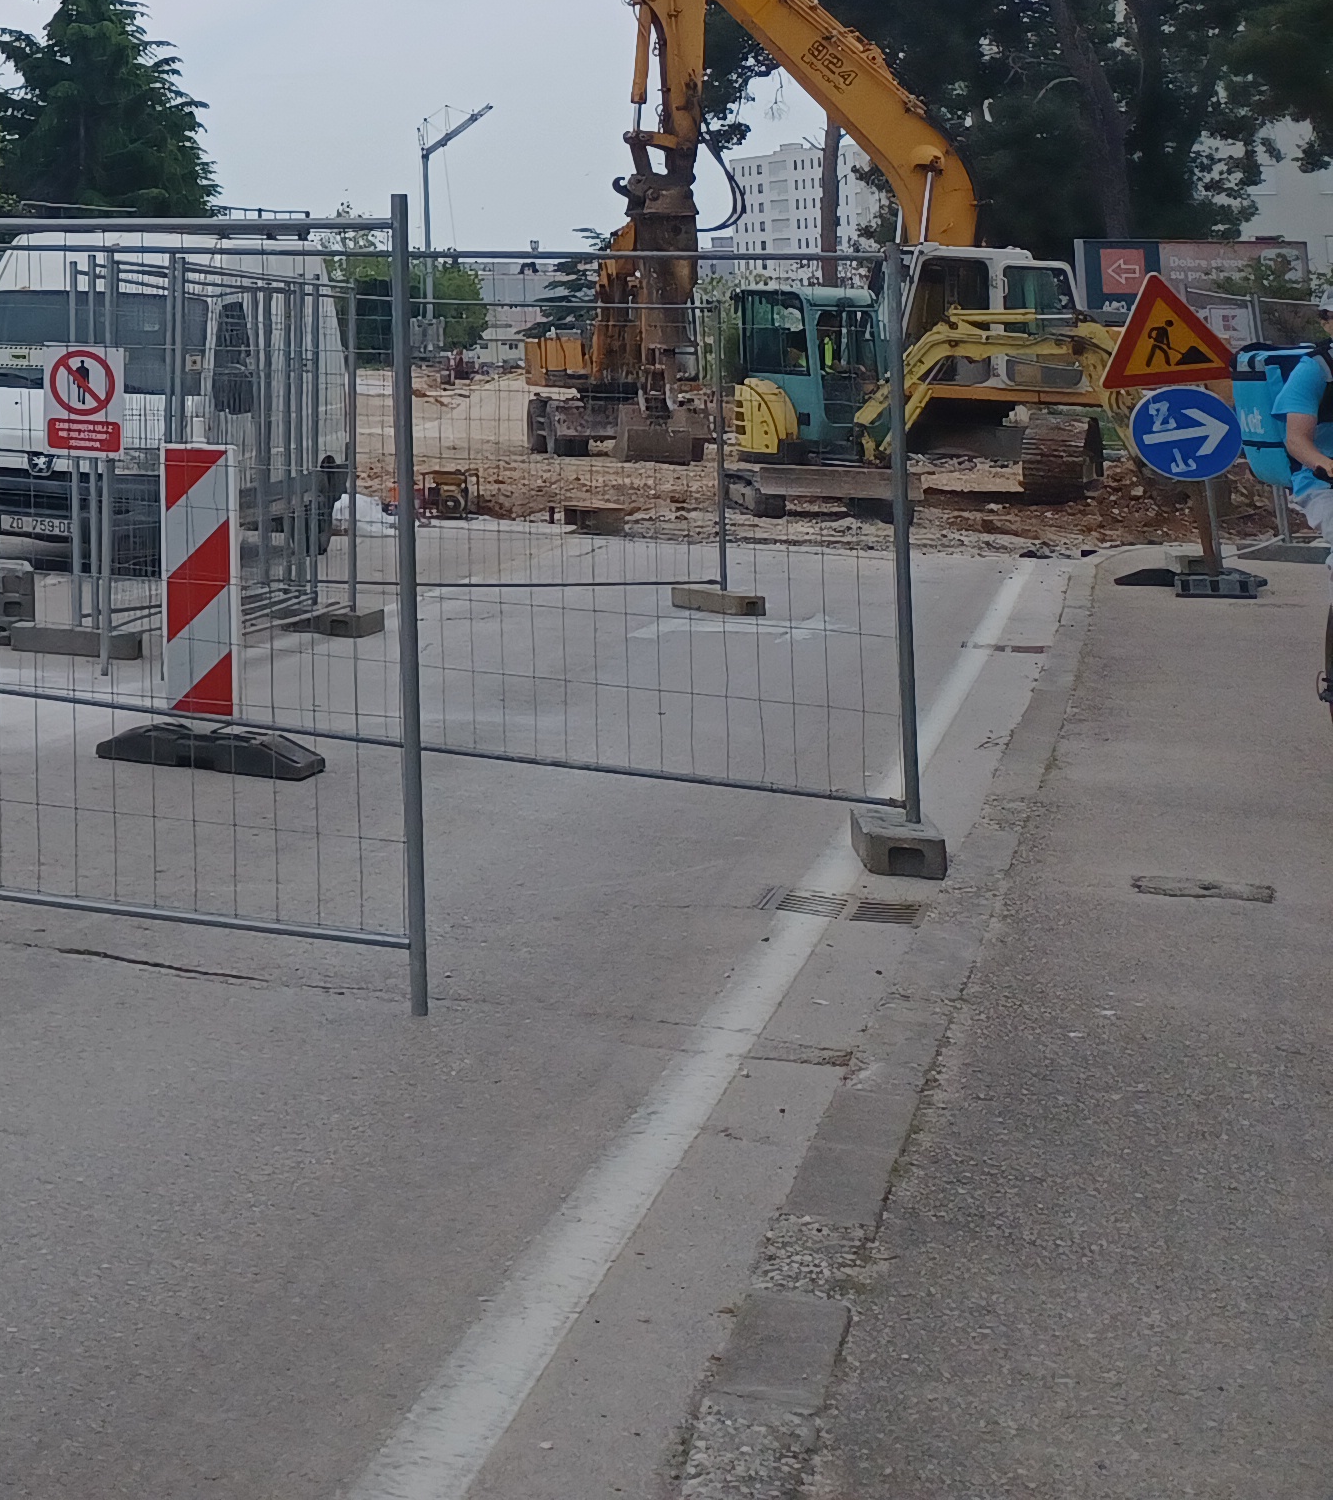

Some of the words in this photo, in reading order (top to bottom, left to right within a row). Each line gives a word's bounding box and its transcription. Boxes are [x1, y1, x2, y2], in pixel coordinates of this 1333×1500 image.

[808, 40, 858, 86] 924
[800, 53, 845, 95] Litronic
[1170, 256, 1207, 267] Dobre
[1170, 271, 1184, 279] su
[9, 516, 24, 530] ZD
